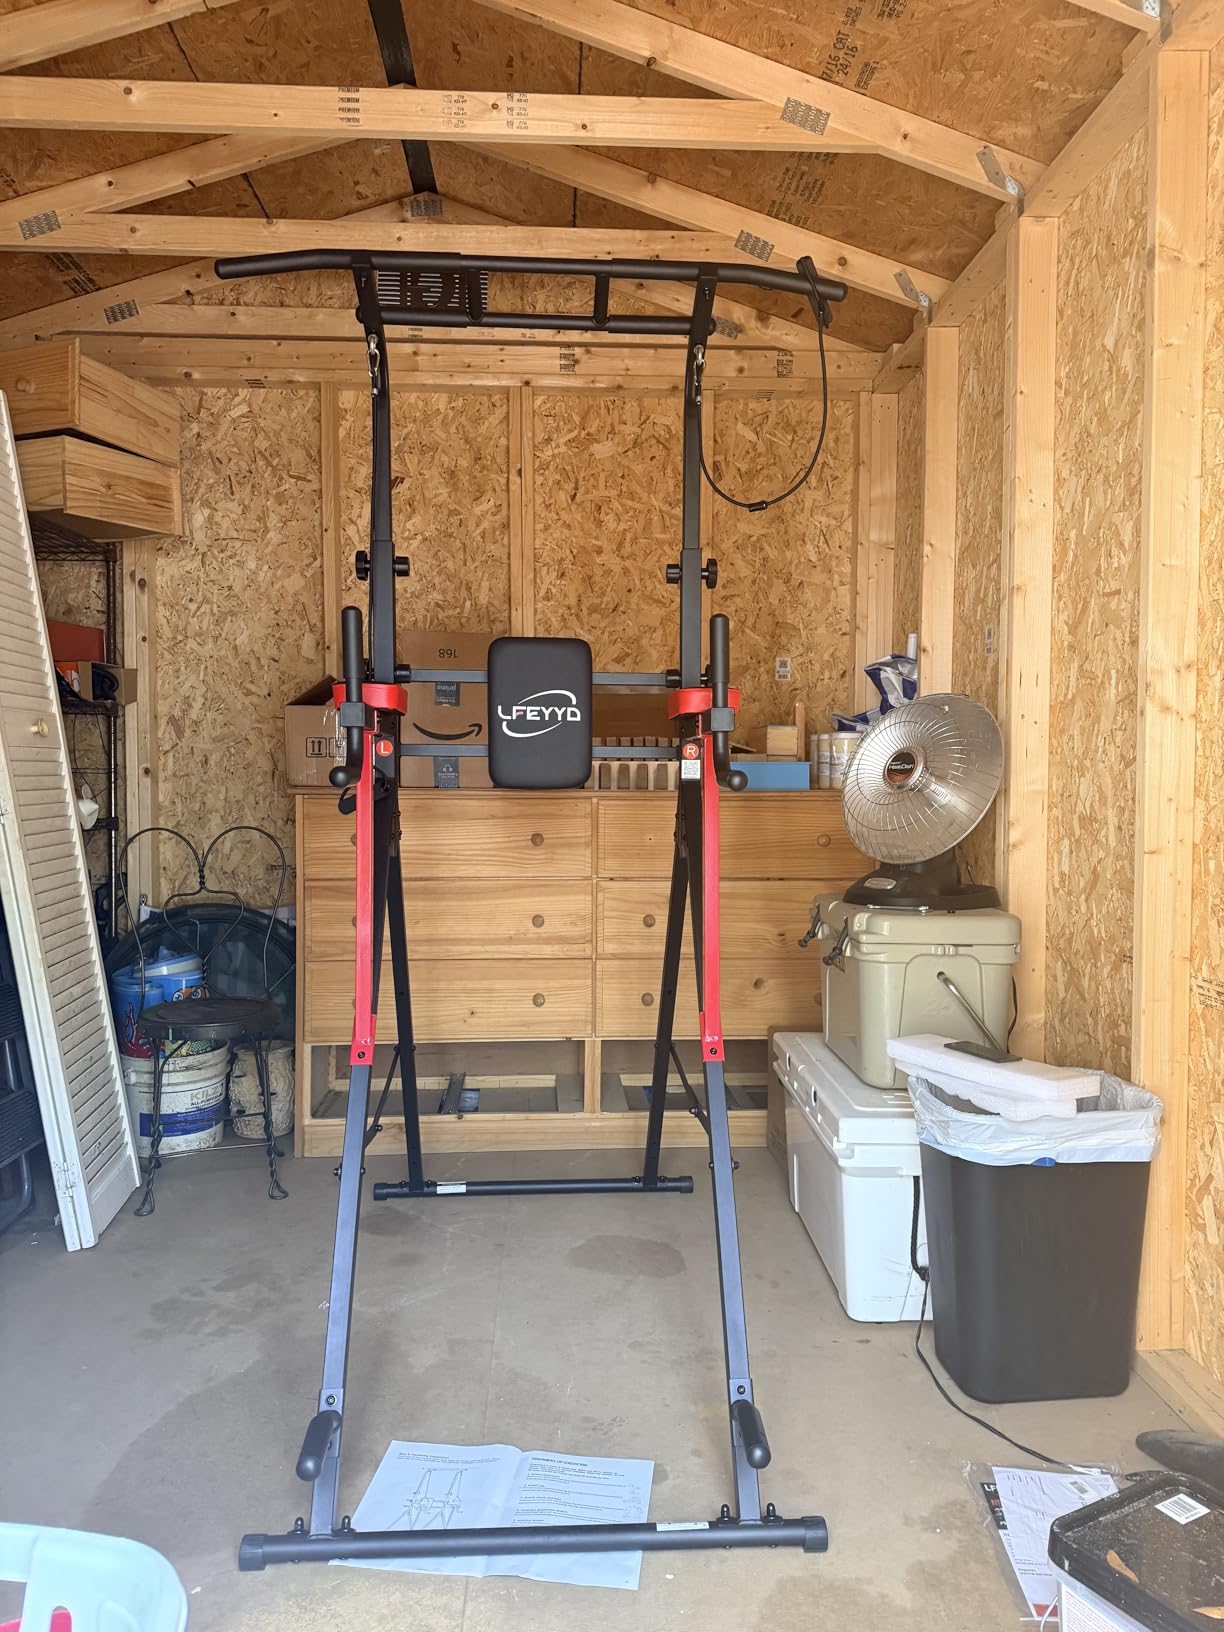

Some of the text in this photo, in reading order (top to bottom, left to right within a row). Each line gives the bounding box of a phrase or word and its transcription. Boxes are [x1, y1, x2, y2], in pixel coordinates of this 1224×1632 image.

[833, 30, 850, 50] CAT
[836, 44, 858, 77] 24/16
[438, 648, 459, 659] 168
[497, 705, 581, 722] LFEYYD
[381, 741, 389, 754] L
[686, 745, 696, 757] R
